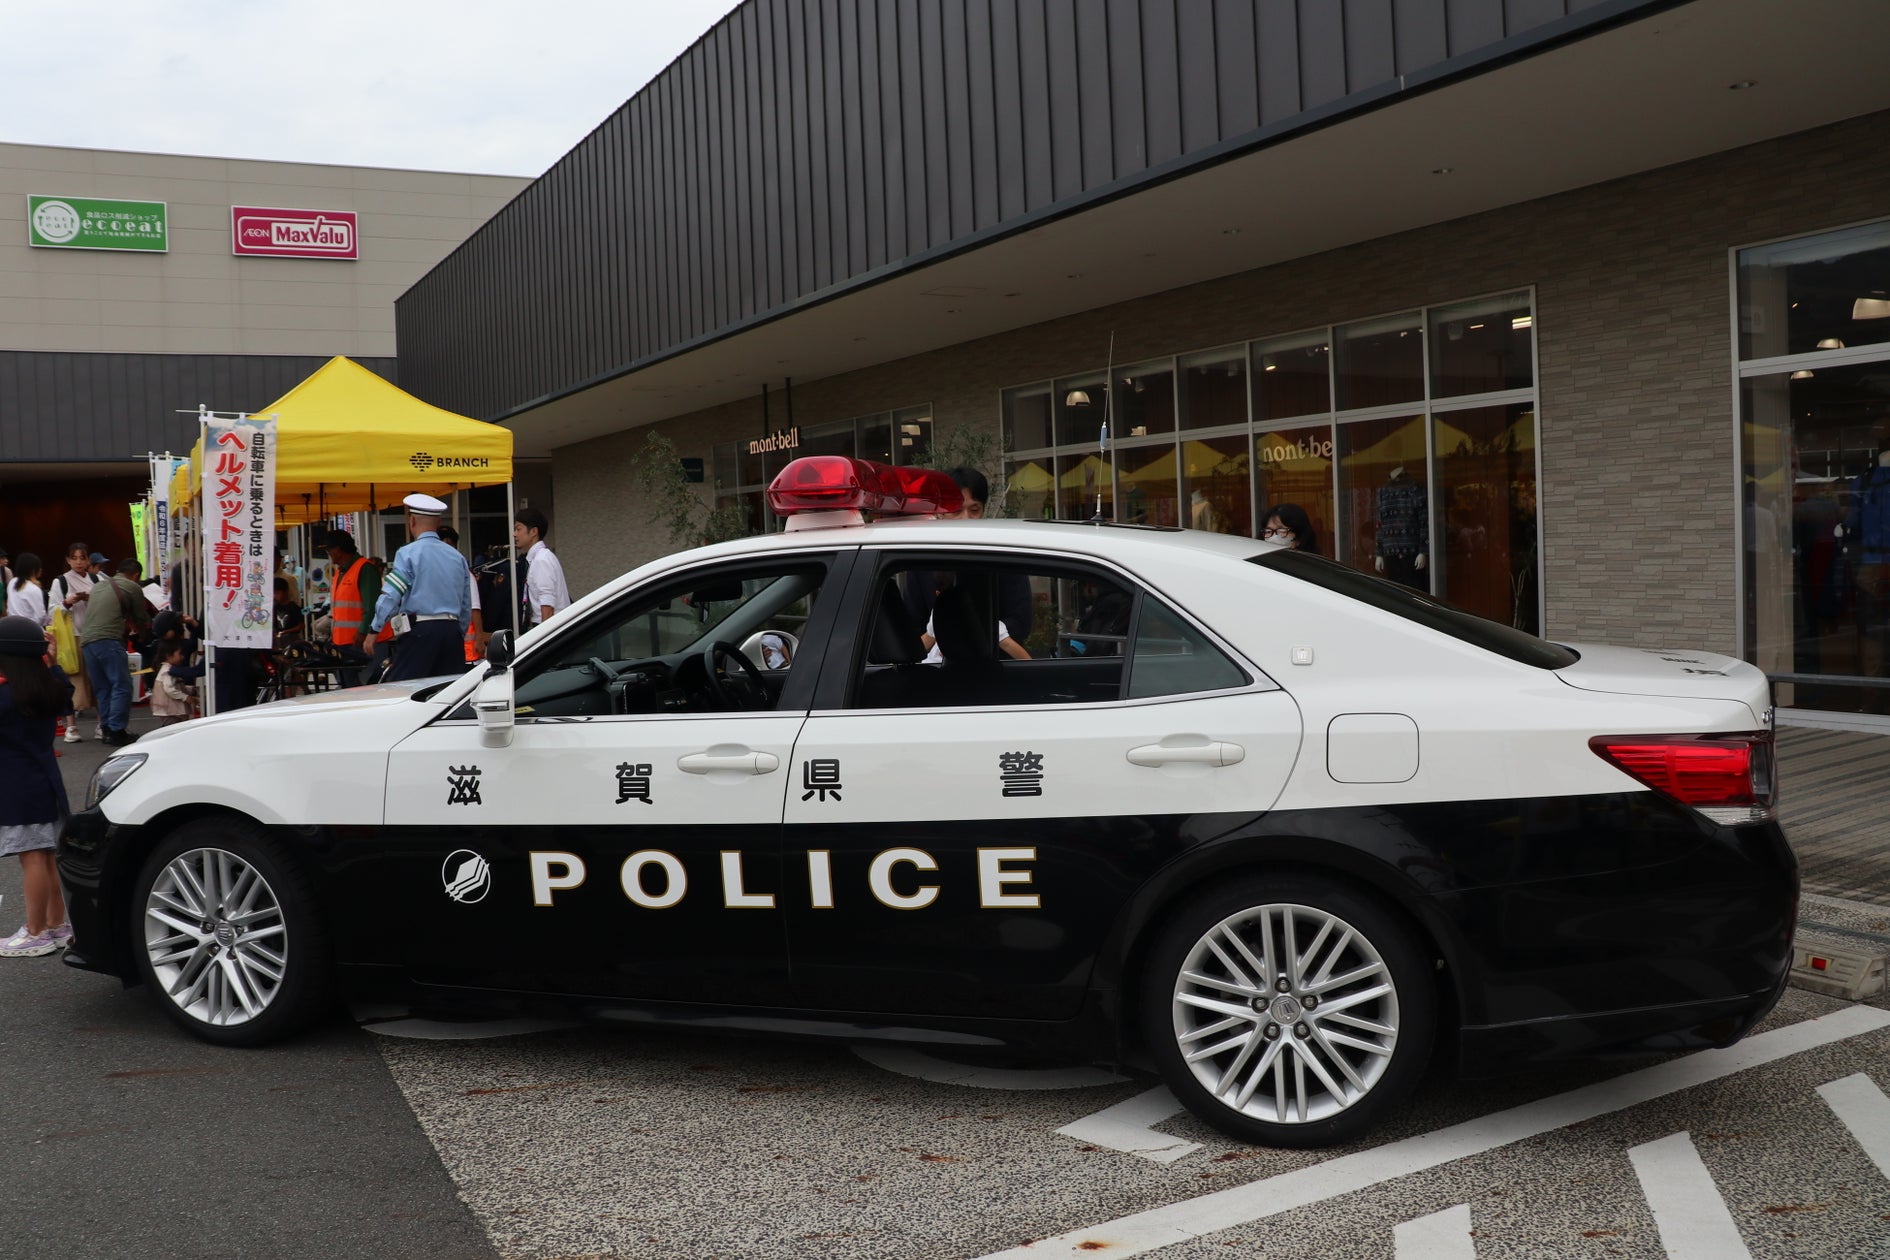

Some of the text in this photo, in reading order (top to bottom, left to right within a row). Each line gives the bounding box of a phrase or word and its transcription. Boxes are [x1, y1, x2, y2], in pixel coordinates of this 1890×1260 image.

[81, 218, 163, 233] ecoeat
[276, 217, 344, 245] MaxValu
[437, 457, 489, 468] BRANCH
[213, 430, 246, 610] ヘルメット着用！
[249, 432, 265, 557] 自転車に乗るときは
[446, 750, 1044, 806] 滋賀県警
[528, 846, 1042, 911] POLICE
